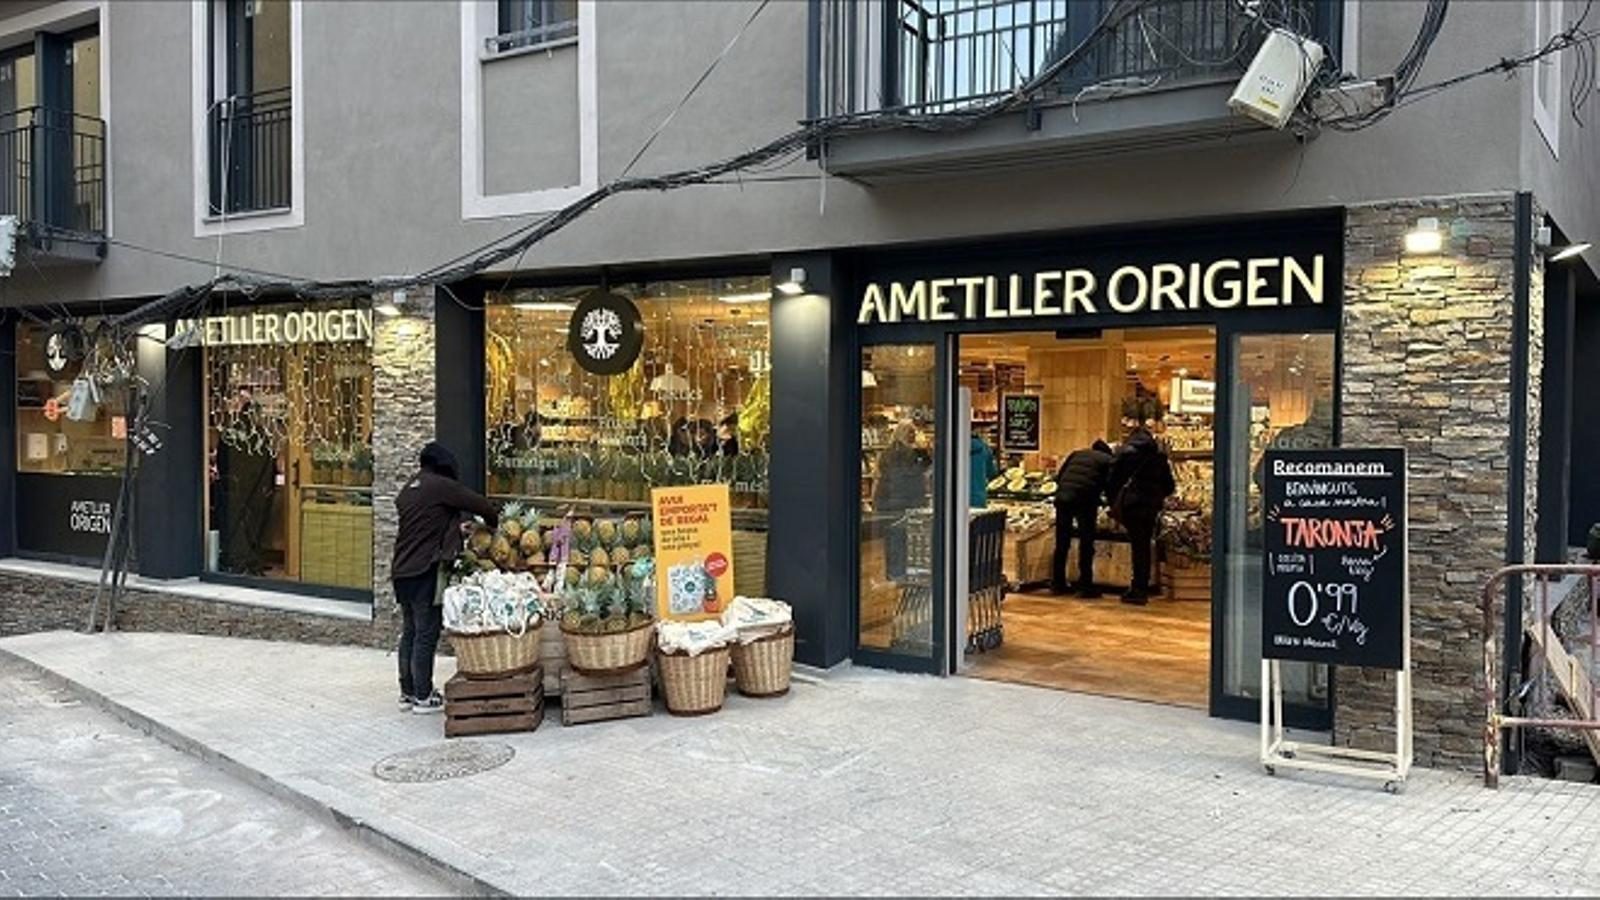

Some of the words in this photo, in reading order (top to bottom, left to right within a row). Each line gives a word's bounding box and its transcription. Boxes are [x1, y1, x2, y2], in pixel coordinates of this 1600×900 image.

[858, 269, 1096, 323] AMETLLER
[1107, 255, 1324, 313] ORIGEN
[284, 309, 373, 344] ORIGEN
[1273, 459, 1387, 475] Recomanem
[71, 501, 111, 514] AMETLLER
[71, 513, 112, 533] ORIGEN
[1280, 517, 1384, 551] TARONJA
